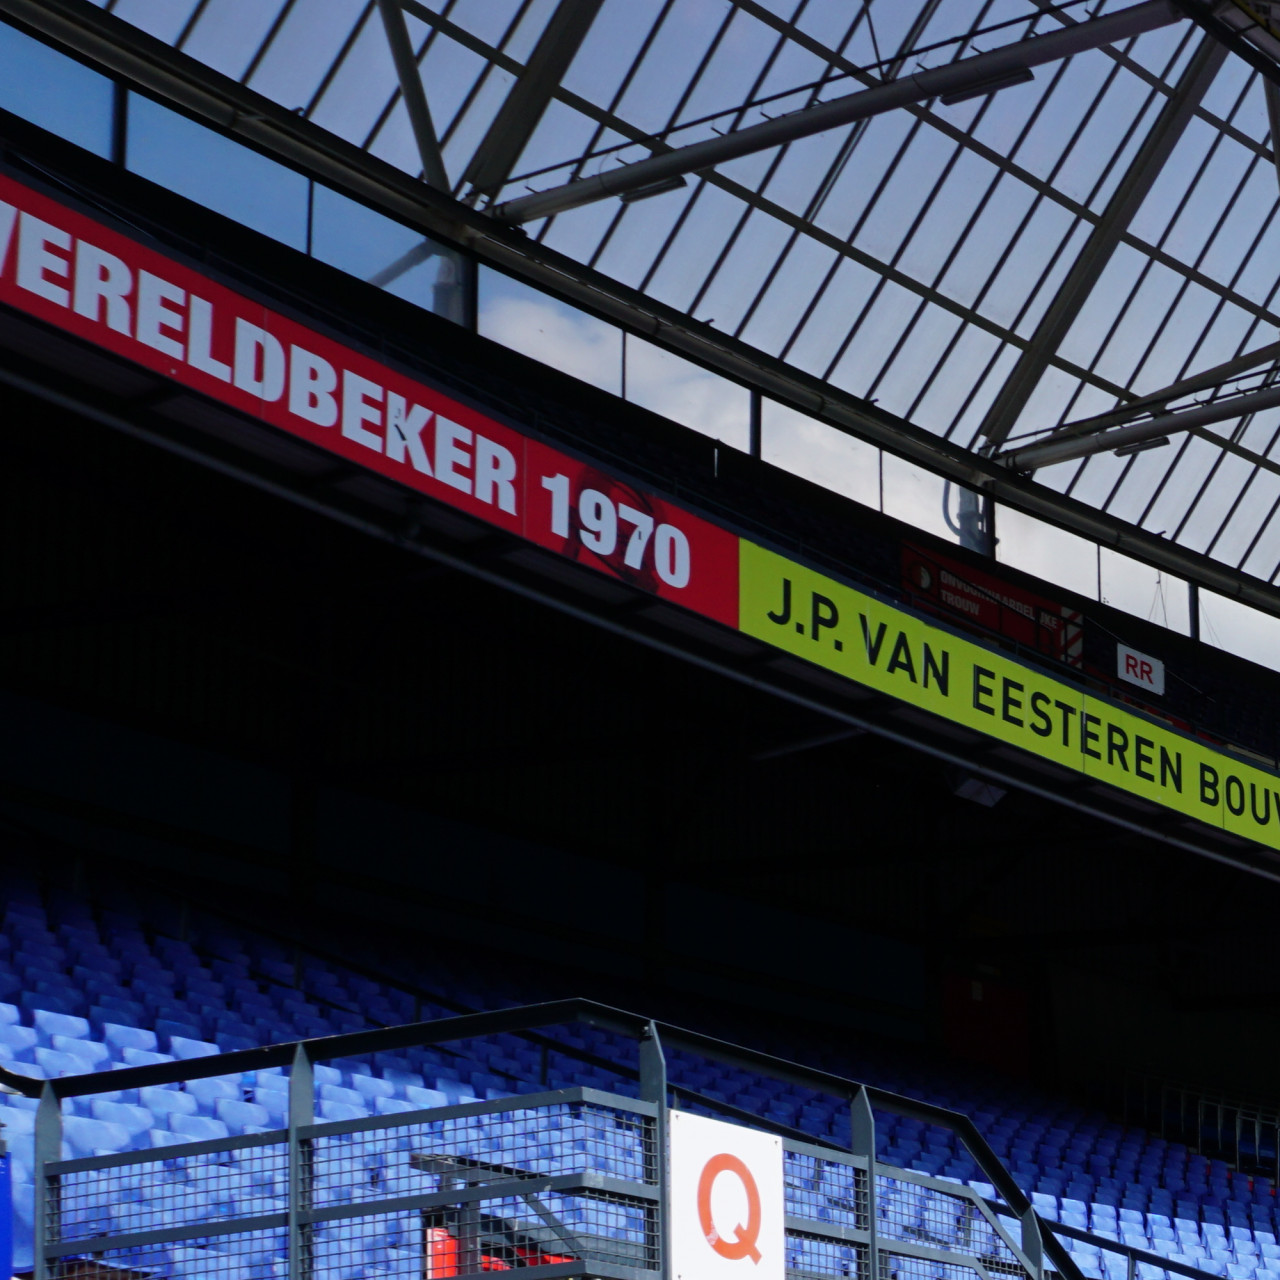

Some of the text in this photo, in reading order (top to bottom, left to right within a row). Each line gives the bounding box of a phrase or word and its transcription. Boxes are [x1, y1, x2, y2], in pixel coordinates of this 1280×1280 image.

[0, 200, 690, 588] ERELDBEKER 1970
[940, 570, 1058, 629] ONVOORWAARDELJKE
[767, 578, 843, 652] J.P.
[859, 613, 949, 697] VAN
[973, 664, 1182, 794] EESTEREN
[1125, 653, 1154, 685] RR
[697, 1153, 763, 1266] Q
